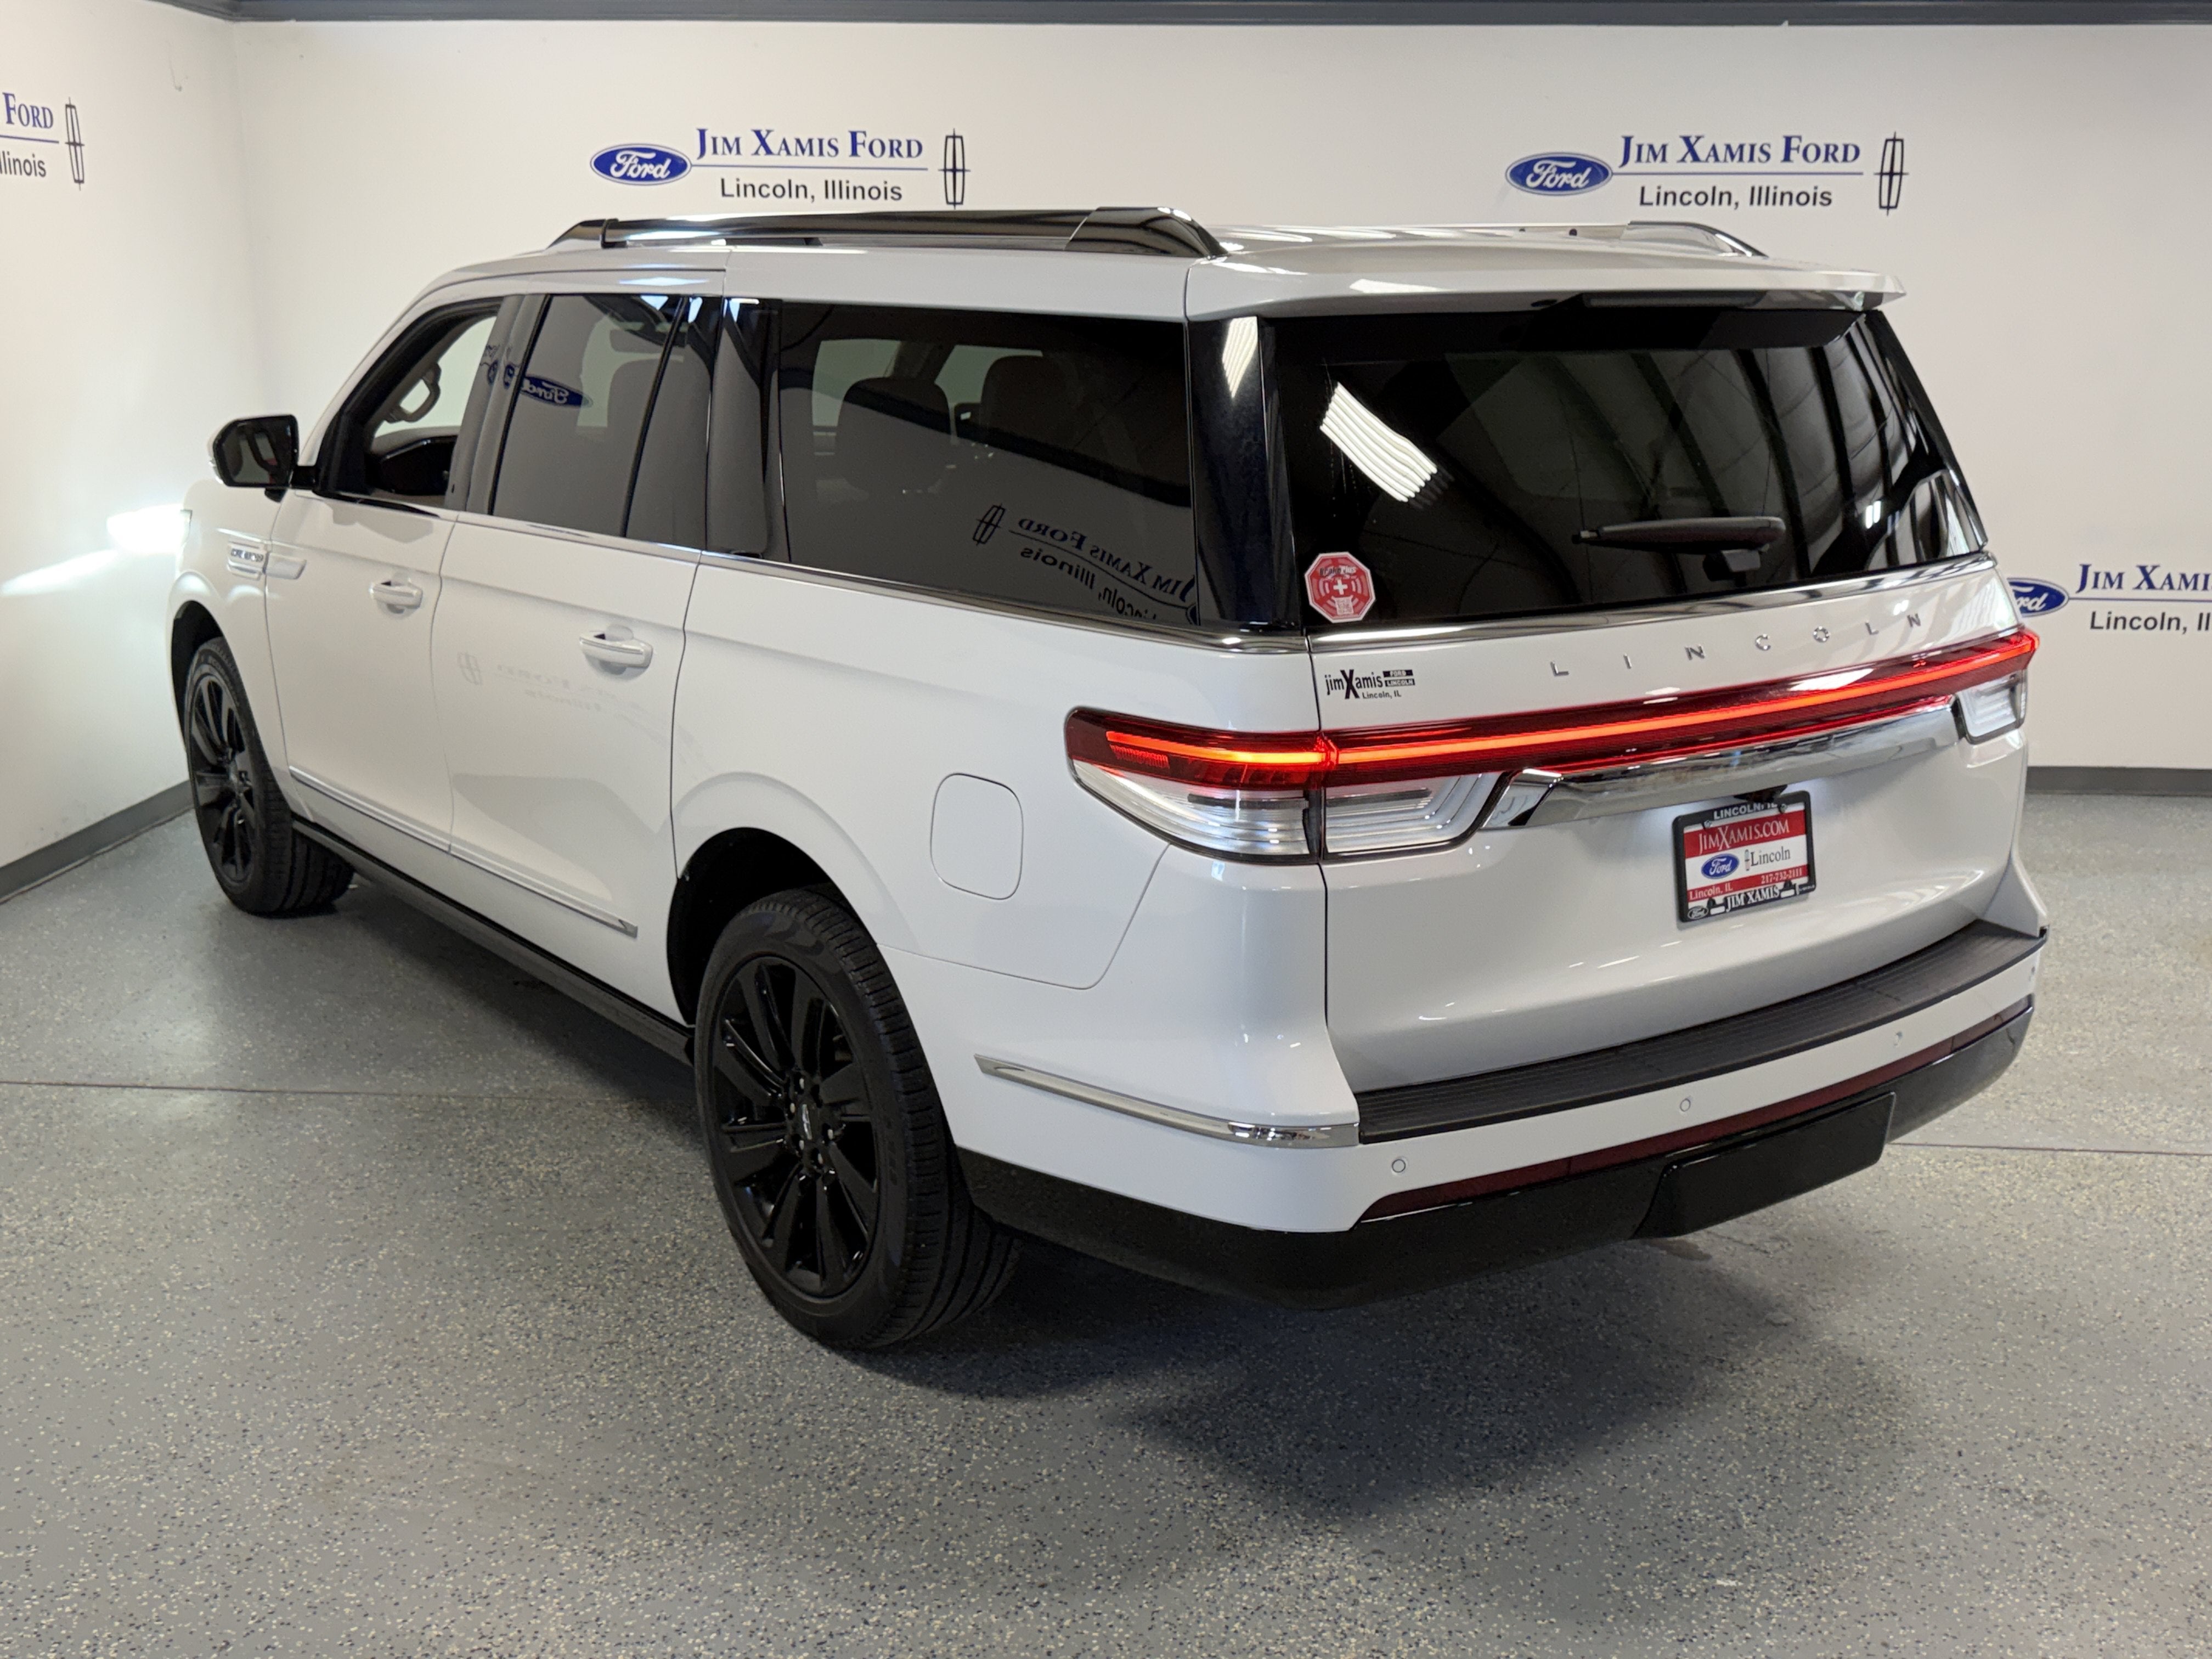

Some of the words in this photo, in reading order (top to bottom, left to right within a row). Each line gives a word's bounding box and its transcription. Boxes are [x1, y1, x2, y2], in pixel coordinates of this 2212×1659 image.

[610, 151, 671, 179] Ford
[1526, 159, 1592, 189] Ford
[720, 177, 815, 202] Lincoln,
[824, 179, 902, 201] Illinois
[1639, 185, 1739, 210] Lincoln,
[1749, 186, 1832, 207] Illinois
[2132, 565, 2212, 591] XAMI
[2090, 611, 2187, 635] Lincoln,
[1550, 613, 1922, 678] LINCOLN
[1362, 691, 1392, 699] Lincoln,
[1713, 802, 1764, 820] LINCOLN,
[1751, 846, 1791, 867] Lincoln
[1690, 883, 1723, 900] Lincoln,
